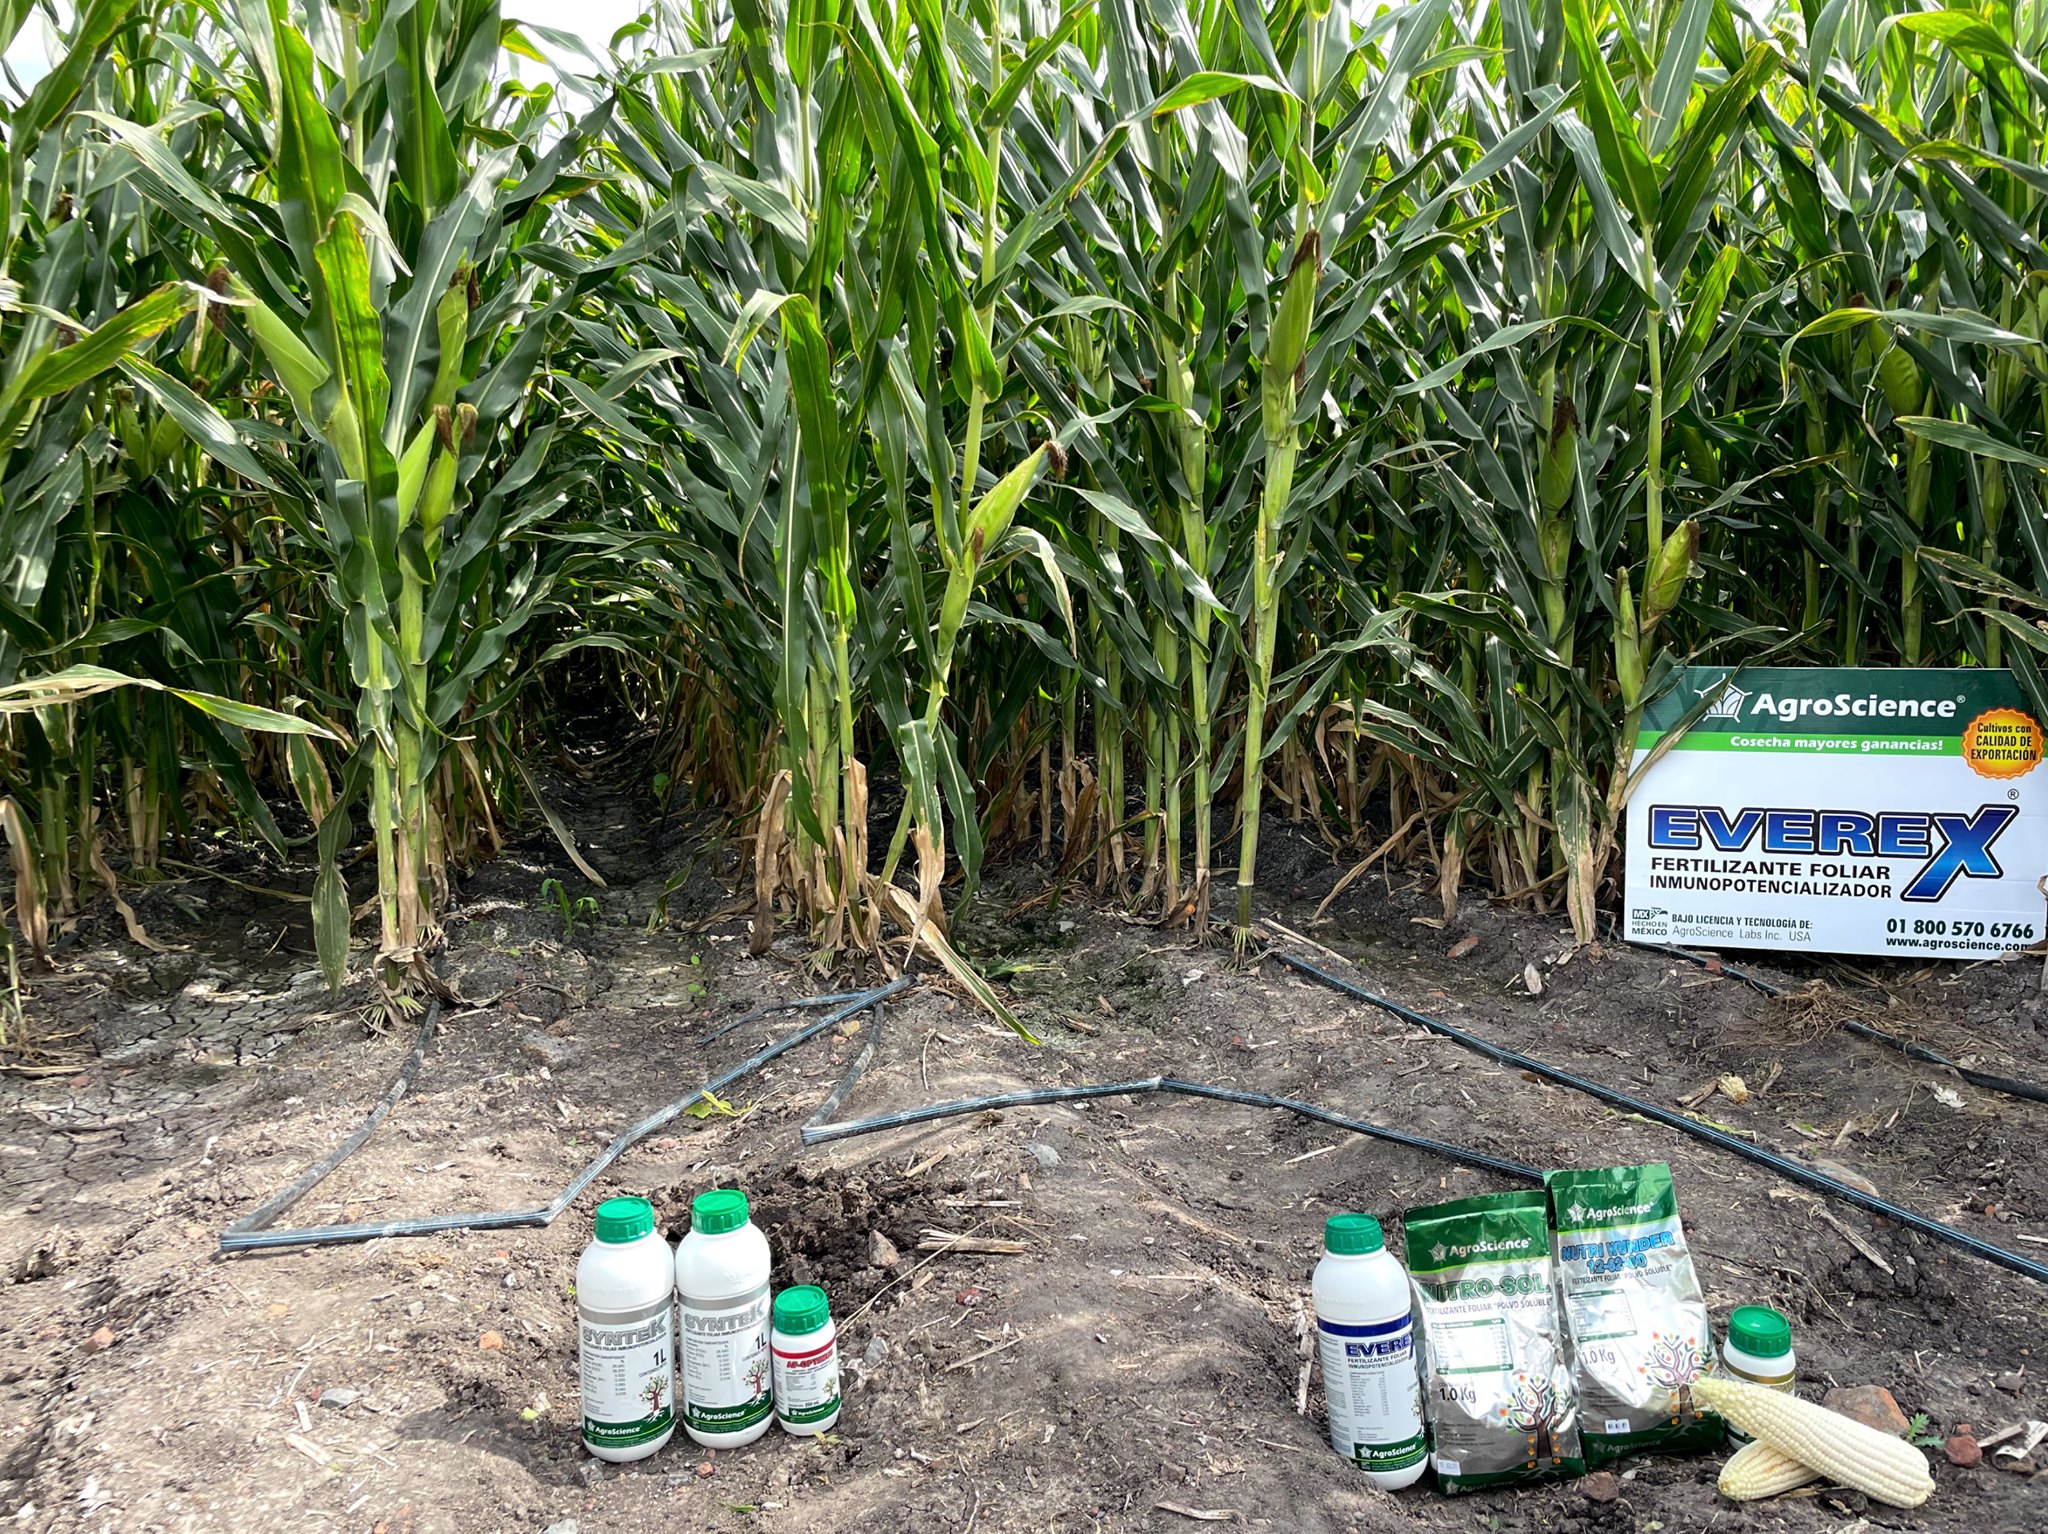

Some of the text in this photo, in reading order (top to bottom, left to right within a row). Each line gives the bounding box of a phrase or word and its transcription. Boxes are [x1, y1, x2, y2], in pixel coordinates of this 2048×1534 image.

[1751, 693, 1957, 722] AgroScience
[1977, 723, 2032, 733] Cultivos con
[1730, 736, 1944, 752] Cosecha mayores ganancias!
[1976, 735, 2032, 747] CALIDAD DE
[1970, 747, 2037, 761] EXPORTACIÓN
[1648, 804, 2019, 902] EVEREX
[1651, 857, 1891, 880] FERTILIZANTE FOLIAR
[1650, 875, 1892, 898] INMUNOPOTENCIALIZADOR
[1632, 920, 1657, 928] HECHO
[1672, 913, 1813, 930] BAJO LICENCIA Y TECNOLOGÍA DE:
[1887, 918, 2034, 939] 01 800 570 6766
[1631, 926, 1668, 936] MÉXICO
[1672, 926, 1812, 942] AgroScience Labs Inc. USA
[1886, 937, 2034, 952] www.agroscience.com
[1586, 1204, 1651, 1221] AgroScience
[1449, 1238, 1530, 1258] AgroScience
[1561, 1243, 1604, 1261] NUTRI
[583, 1312, 667, 1346] SYNTEK
[1347, 1355, 1389, 1364] FERTILIZANTE
[1582, 1348, 1616, 1364] 1.0 Kg
[1440, 1386, 1476, 1404] 1.0 Kg
[701, 1410, 745, 1420] AgroScience
[595, 1426, 640, 1435] AgroScience
[1372, 1444, 1416, 1459] AgroScience
